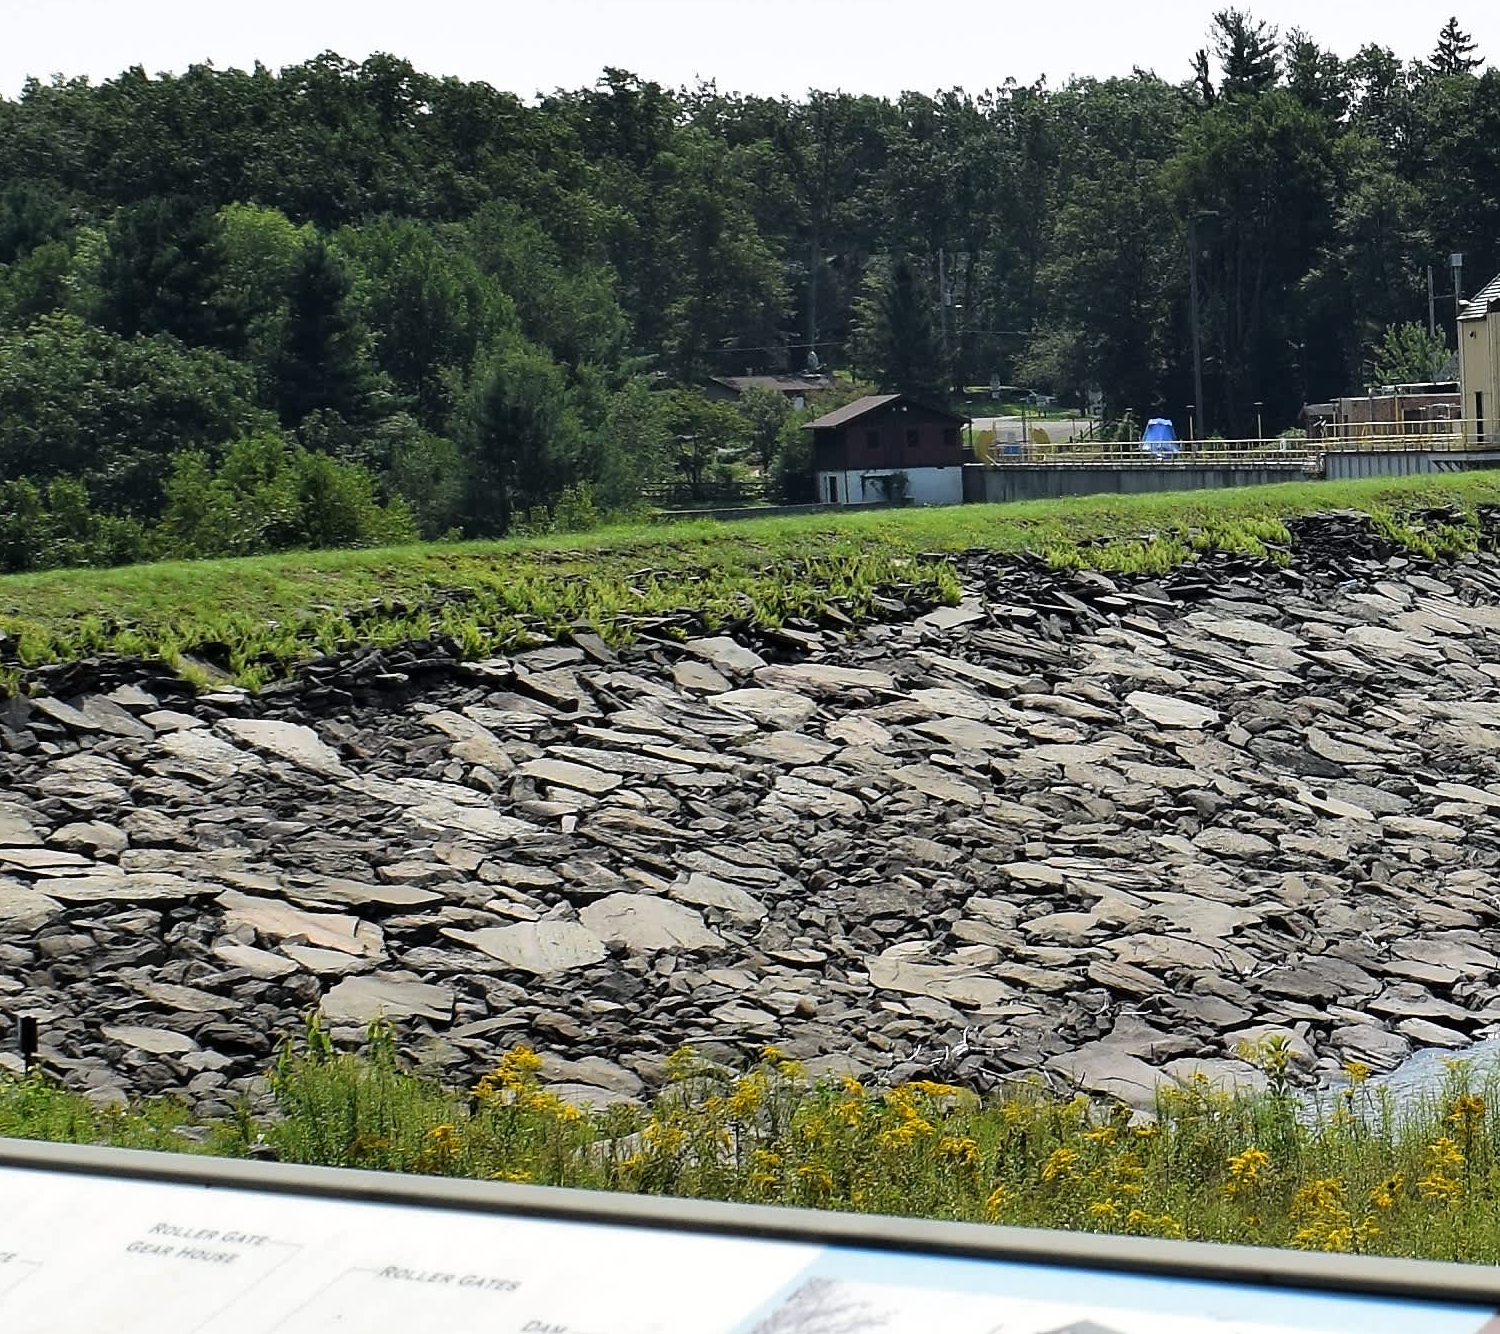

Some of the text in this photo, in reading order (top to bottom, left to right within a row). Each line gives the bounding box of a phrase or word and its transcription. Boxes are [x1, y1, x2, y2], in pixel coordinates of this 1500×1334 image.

[149, 1222, 269, 1247] ROLLER GATE
[125, 1240, 240, 1266] GEAR HOUSE
[379, 1266, 522, 1293] ROLLER GATES
